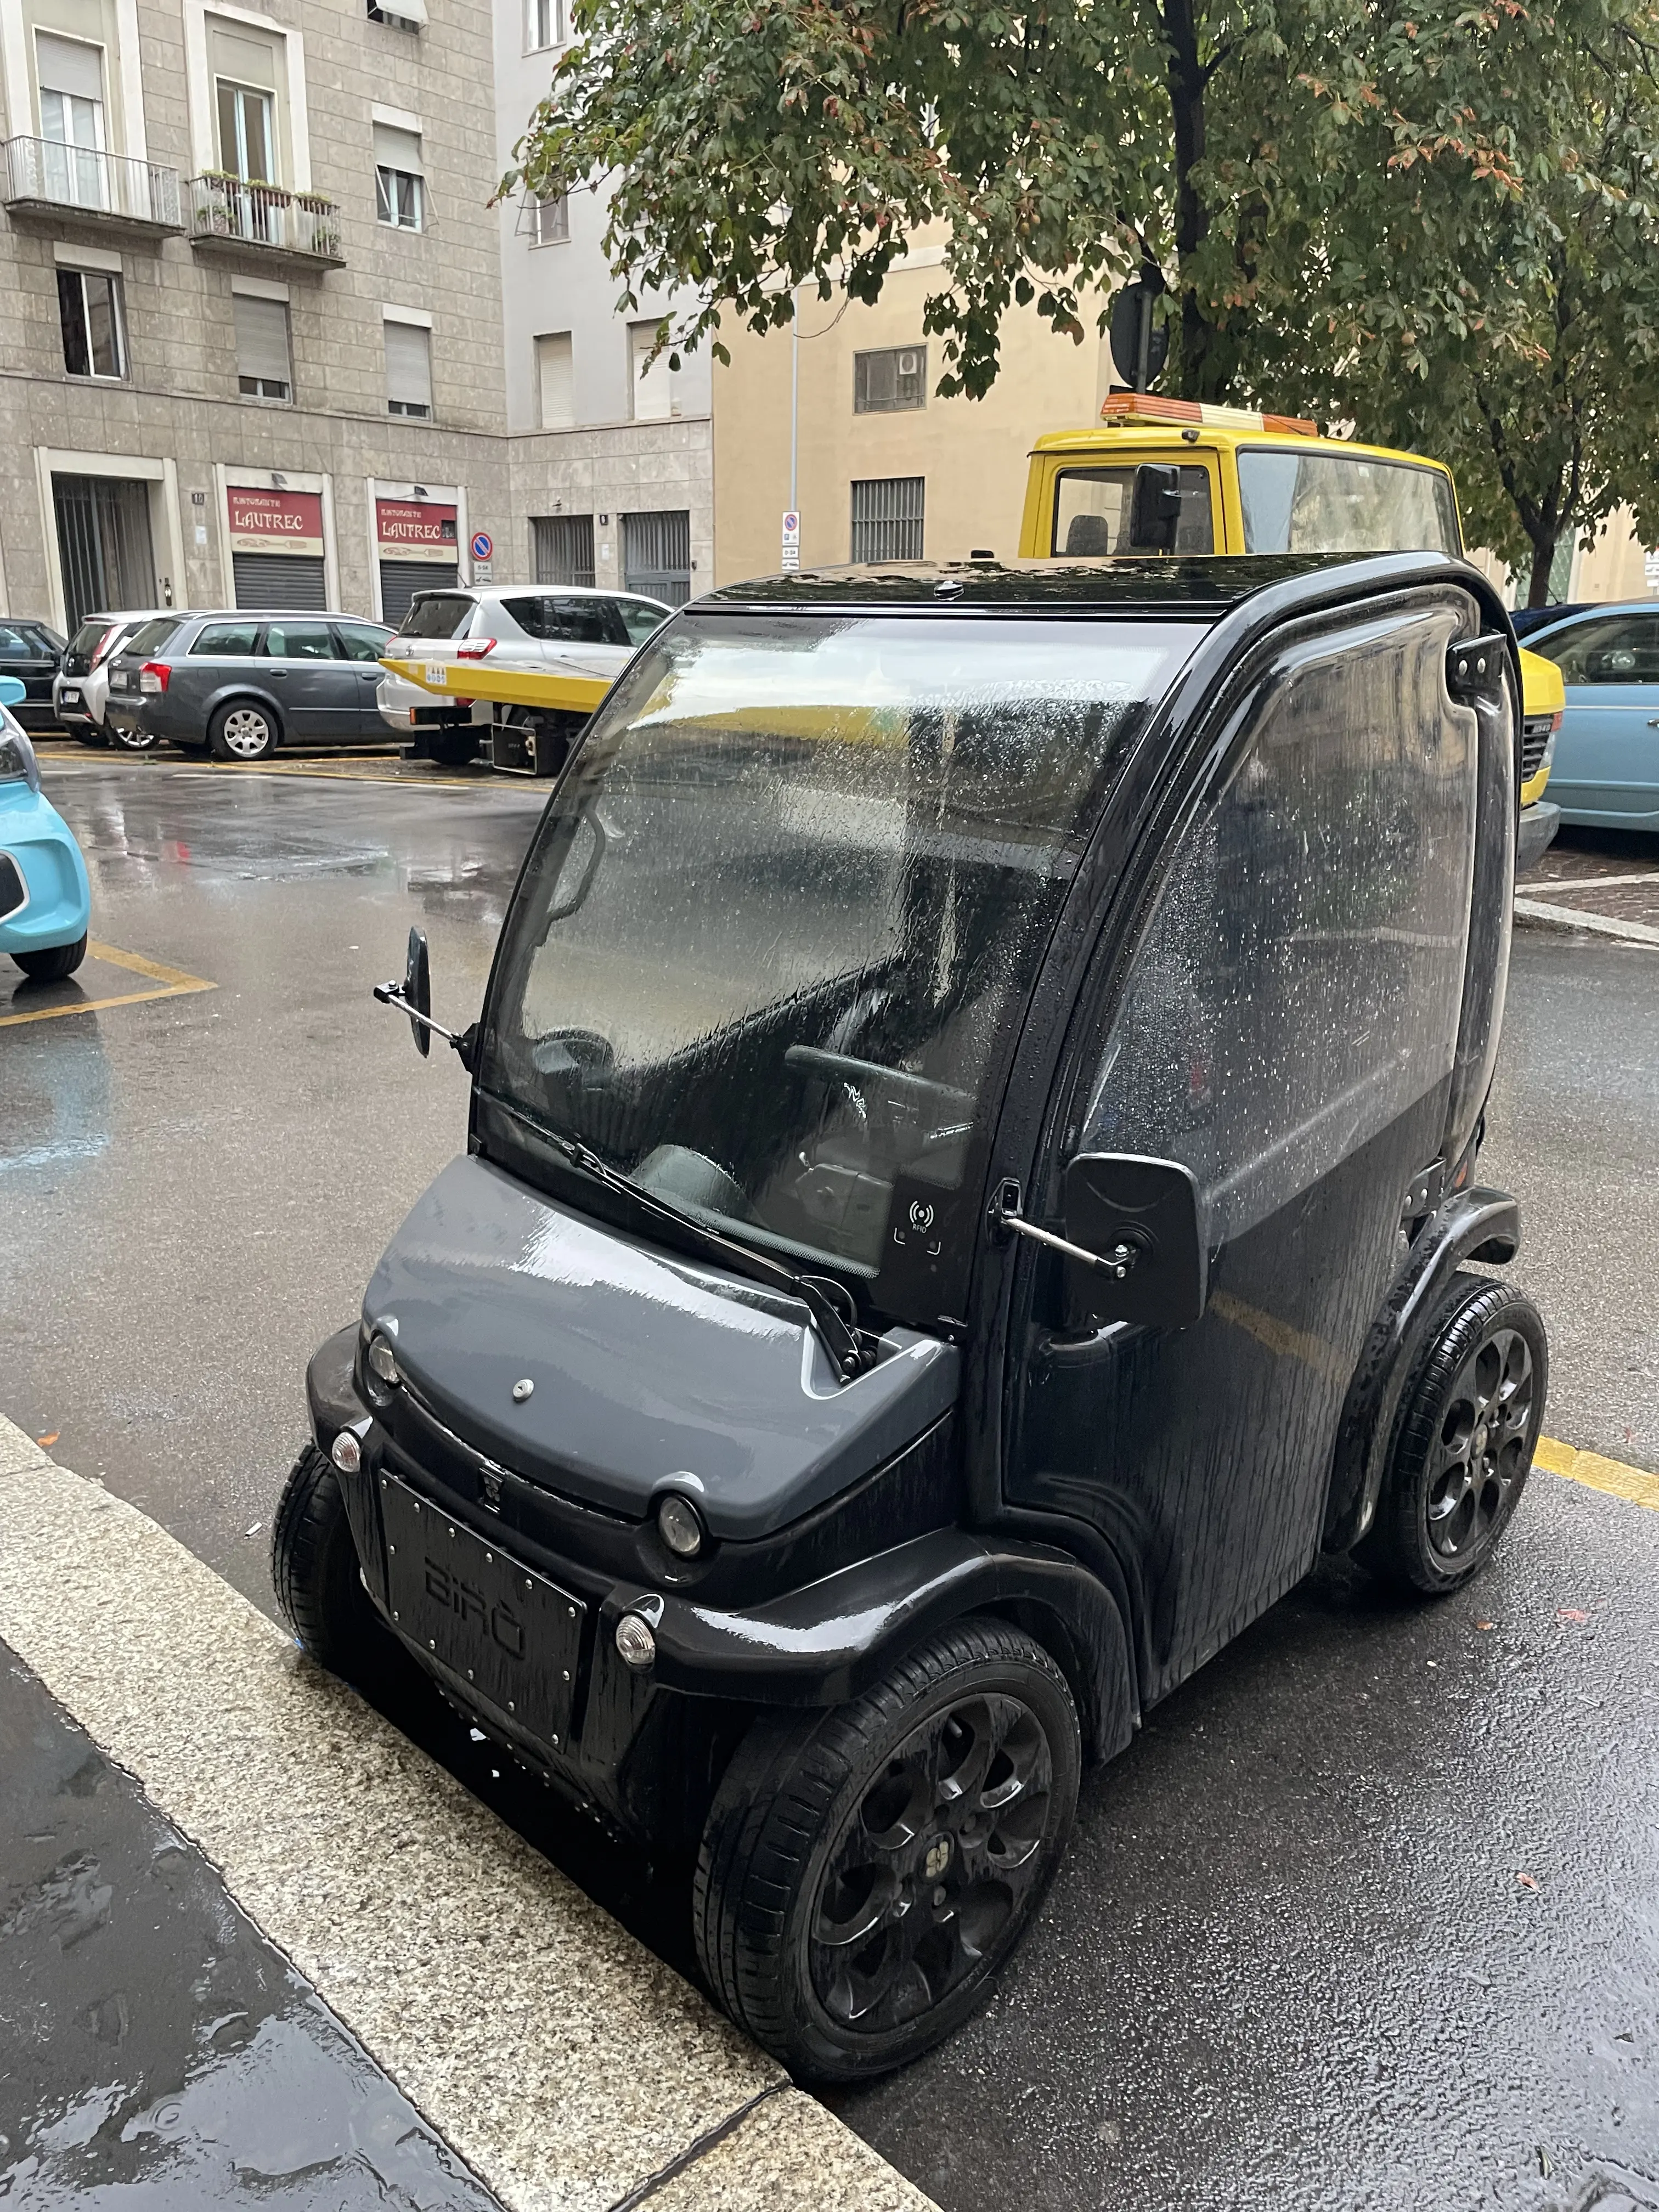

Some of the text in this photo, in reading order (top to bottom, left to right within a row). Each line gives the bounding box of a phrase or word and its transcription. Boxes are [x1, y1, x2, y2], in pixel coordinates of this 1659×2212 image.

[235, 510, 303, 531] LAUTREC
[382, 521, 441, 540] LAUTREC
[912, 1223, 927, 1234] RFID
